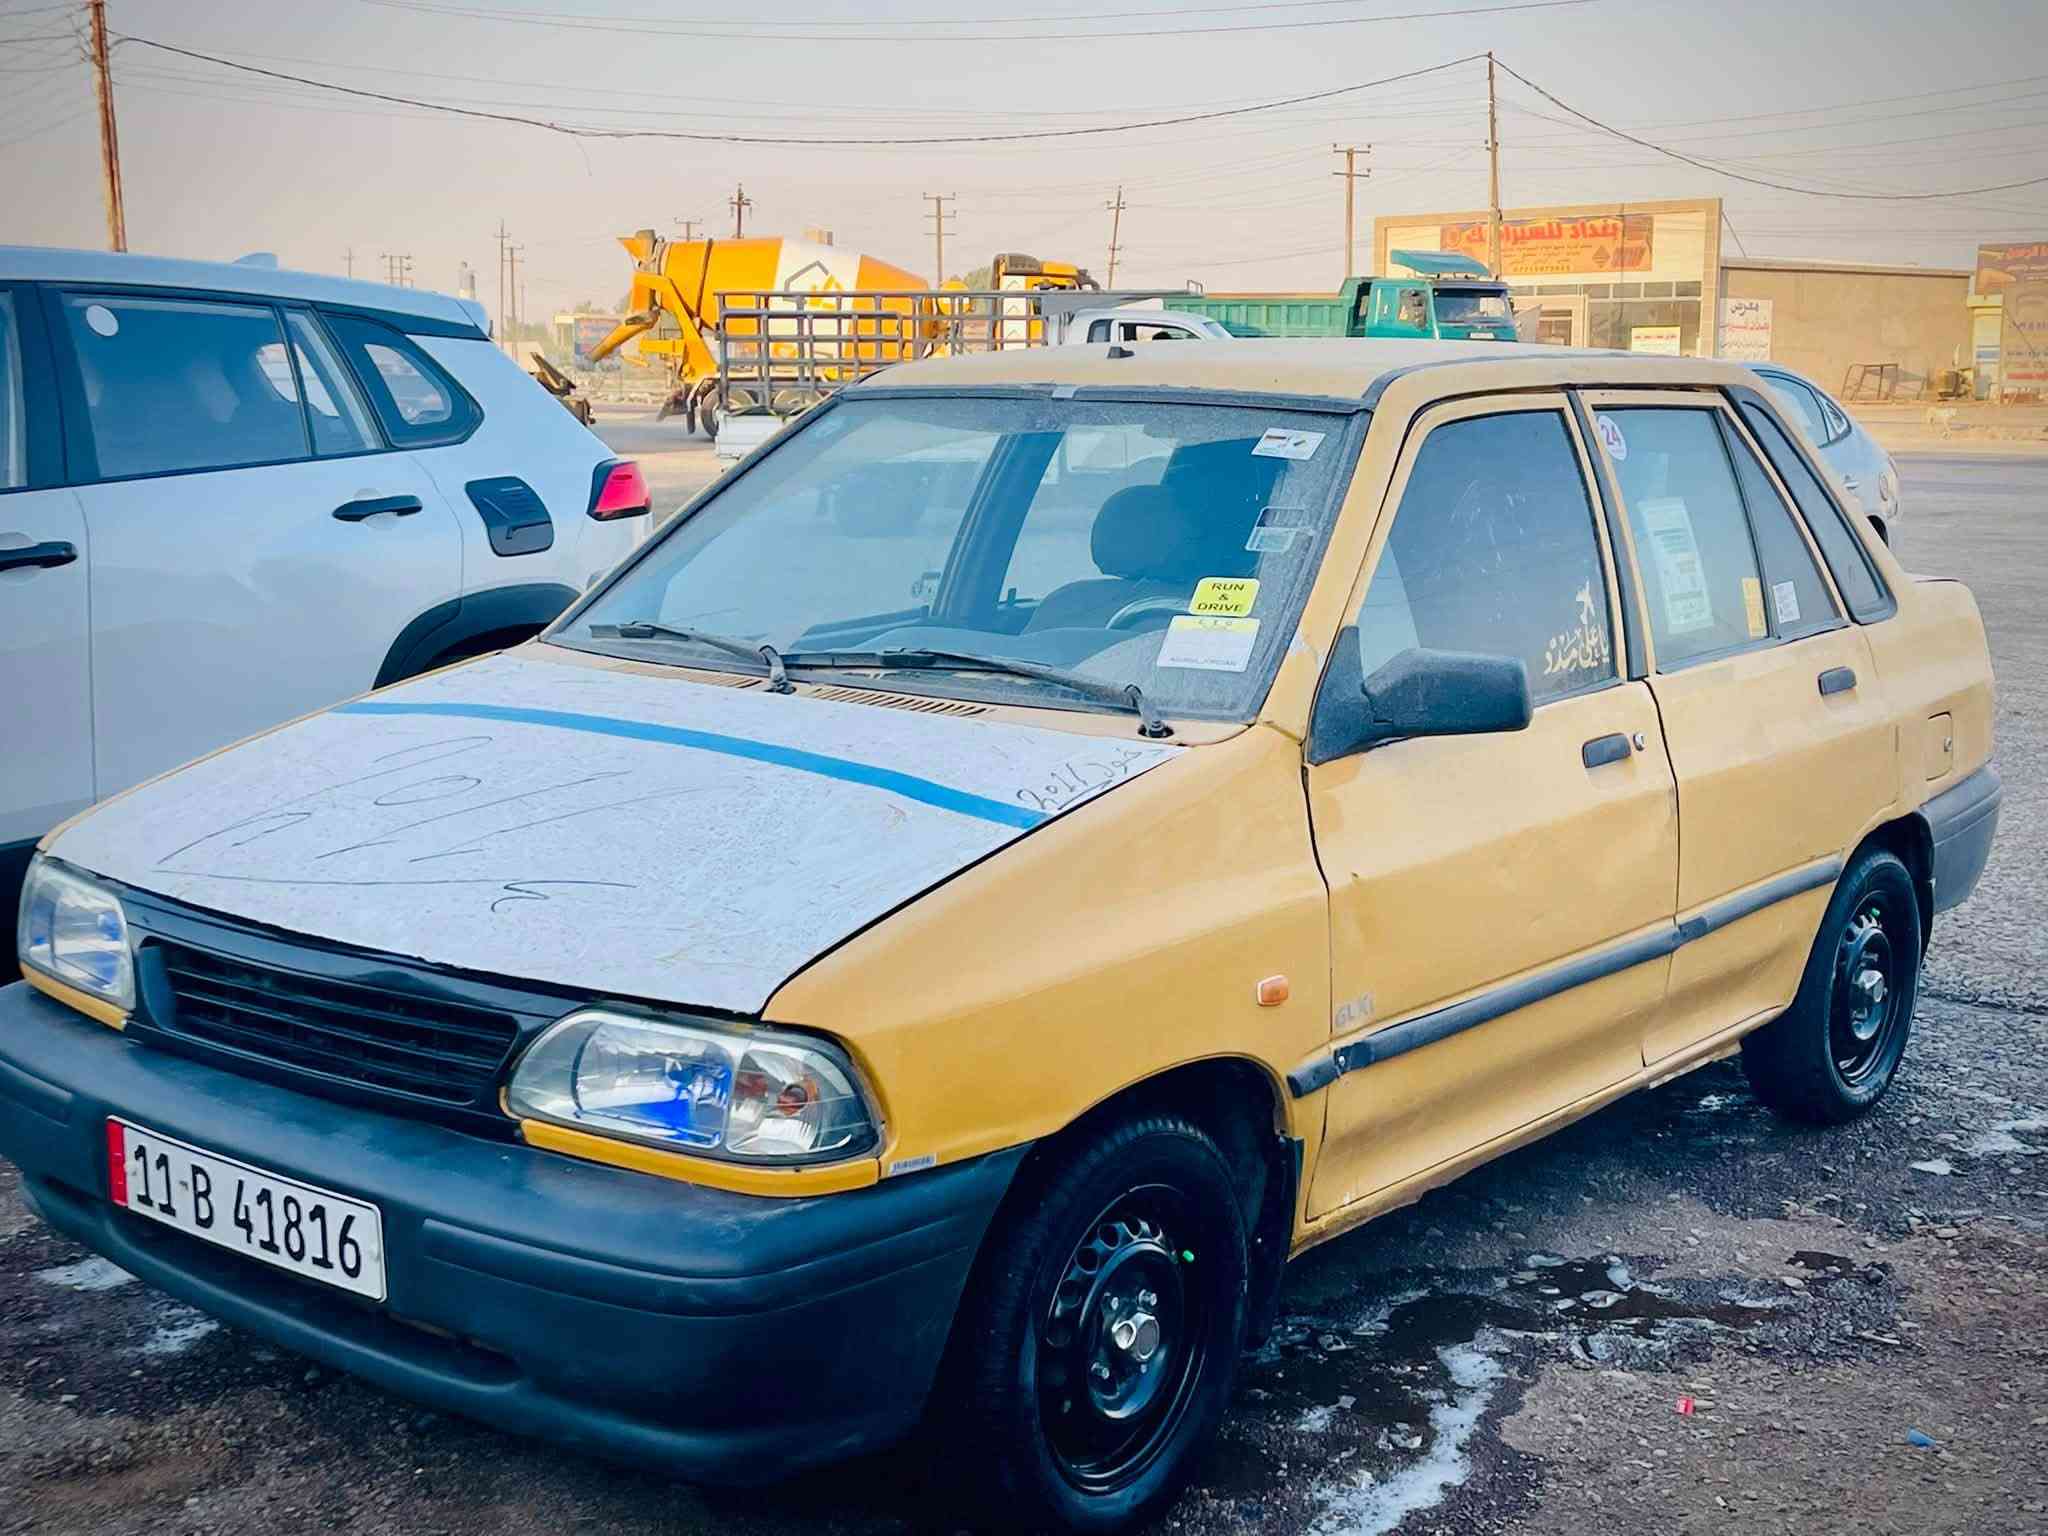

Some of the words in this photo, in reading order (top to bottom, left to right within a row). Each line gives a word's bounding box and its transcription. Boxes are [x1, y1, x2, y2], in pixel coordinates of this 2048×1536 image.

[1211, 582, 1244, 591] RUN
[1196, 602, 1243, 613] DRIVE
[234, 1180, 362, 1279] 41816
